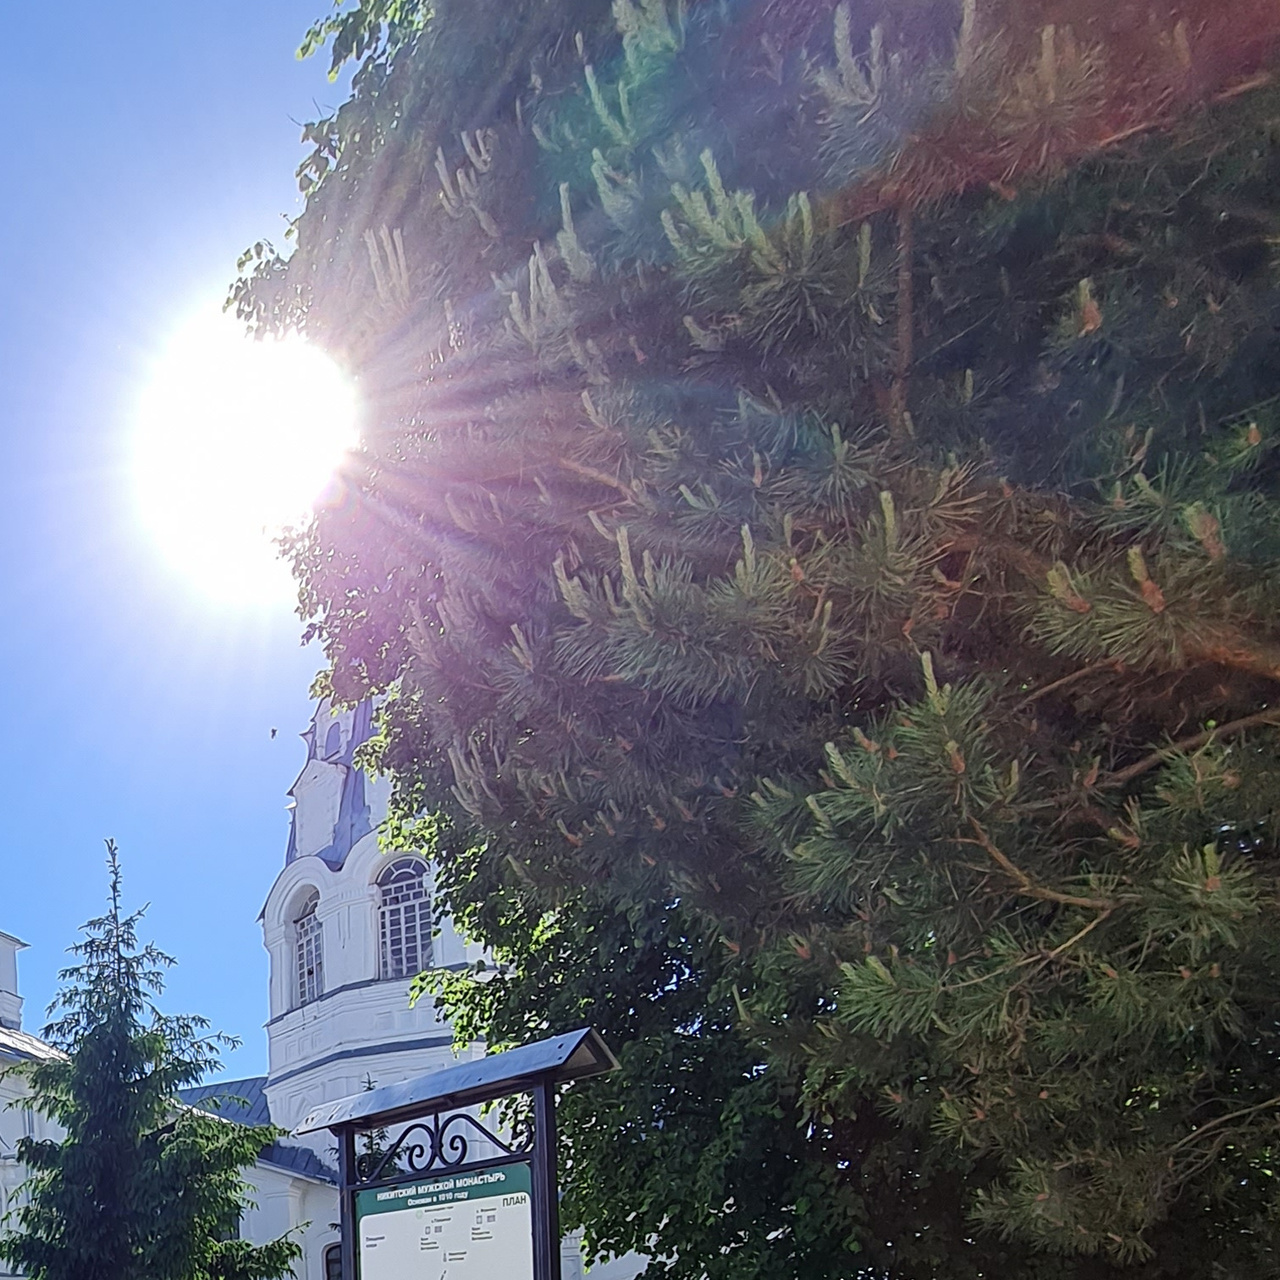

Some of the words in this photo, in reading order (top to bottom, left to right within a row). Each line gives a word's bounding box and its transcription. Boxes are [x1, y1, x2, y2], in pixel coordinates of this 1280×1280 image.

[377, 1185, 417, 1200] НИКИТСКИЙ
[419, 1179, 454, 1194] МУЖСКОЙ
[456, 1172, 505, 1186] МОНАСТЫРЬ
[502, 1195, 527, 1207] ПЛАН
